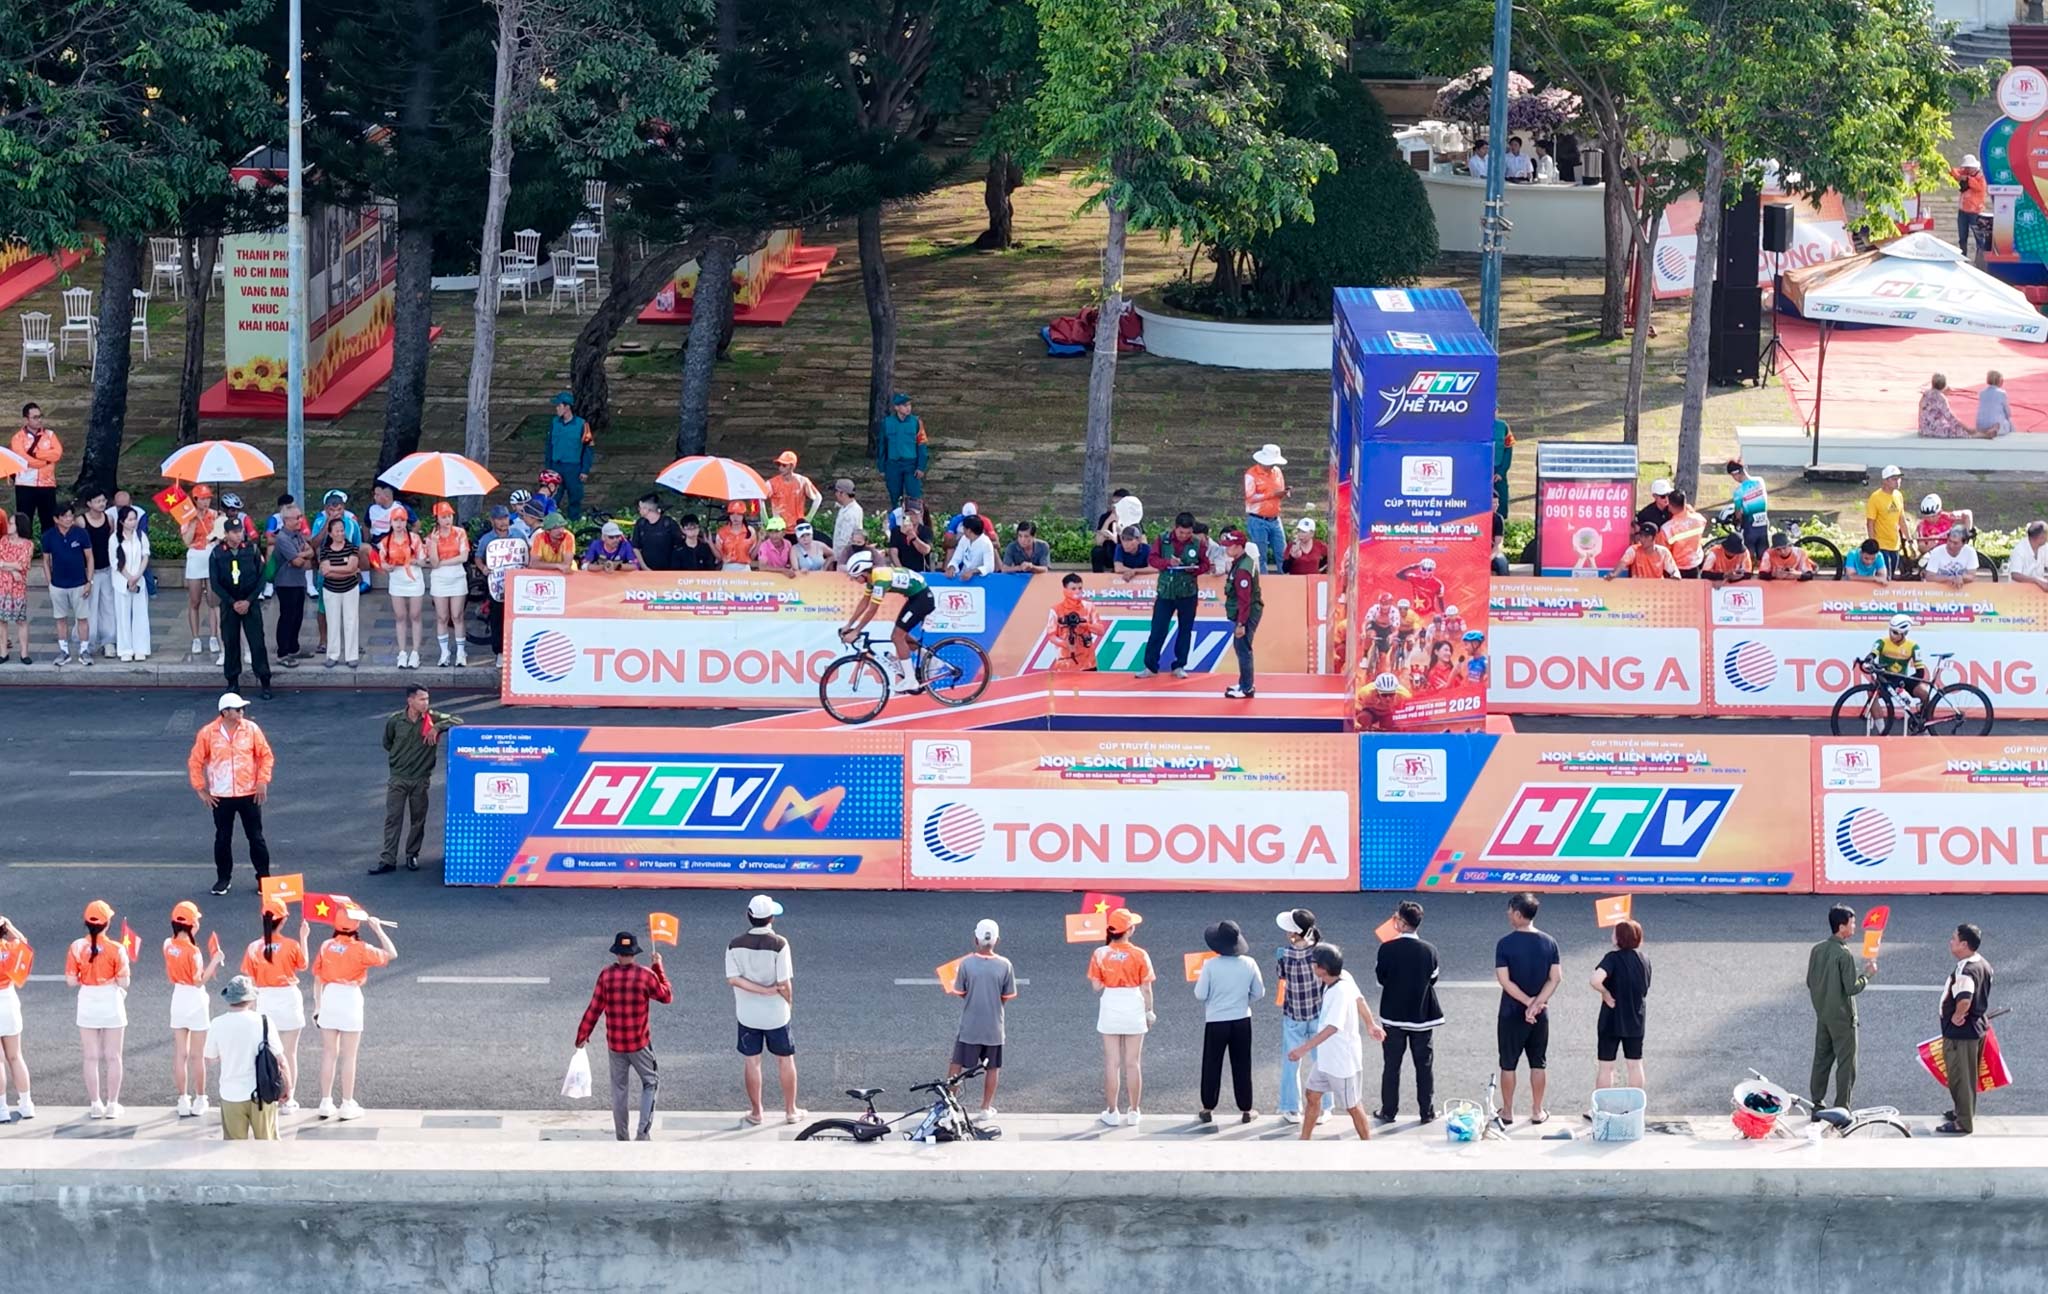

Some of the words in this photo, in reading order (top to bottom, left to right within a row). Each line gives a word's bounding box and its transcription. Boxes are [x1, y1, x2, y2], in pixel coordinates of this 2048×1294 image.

[270, 266, 289, 279] MIN
[1409, 374, 1476, 392] HTV
[1428, 400, 1468, 413] THAO
[1546, 505, 1573, 518] 0901
[1578, 505, 1592, 518] 56
[1595, 506, 1610, 518] 58
[1613, 506, 1627, 519] 56
[625, 590, 657, 600] NON
[663, 588, 702, 602] SÔNG
[1822, 600, 1856, 612] NON
[583, 648, 685, 683] TON
[699, 648, 836, 684] DONG
[1506, 655, 1645, 690] DONG
[1654, 657, 1690, 691] A
[1449, 696, 1481, 713] 2026
[1039, 756, 1075, 767] NON
[1083, 754, 1126, 769] SÔNG
[1170, 756, 1205, 770] MỘT
[1541, 751, 1572, 761] NON
[1578, 750, 1615, 763] SÔNG
[1947, 760, 1982, 771] NON
[1988, 757, 2031, 772] SÔNG
[563, 769, 774, 823] HTV
[1489, 791, 1732, 854] HTV
[993, 822, 1109, 863] TON
[1126, 823, 1285, 864] DONG
[1295, 825, 1337, 864] A
[1904, 826, 2017, 866] TON
[578, 860, 617, 868] htv.com.vn
